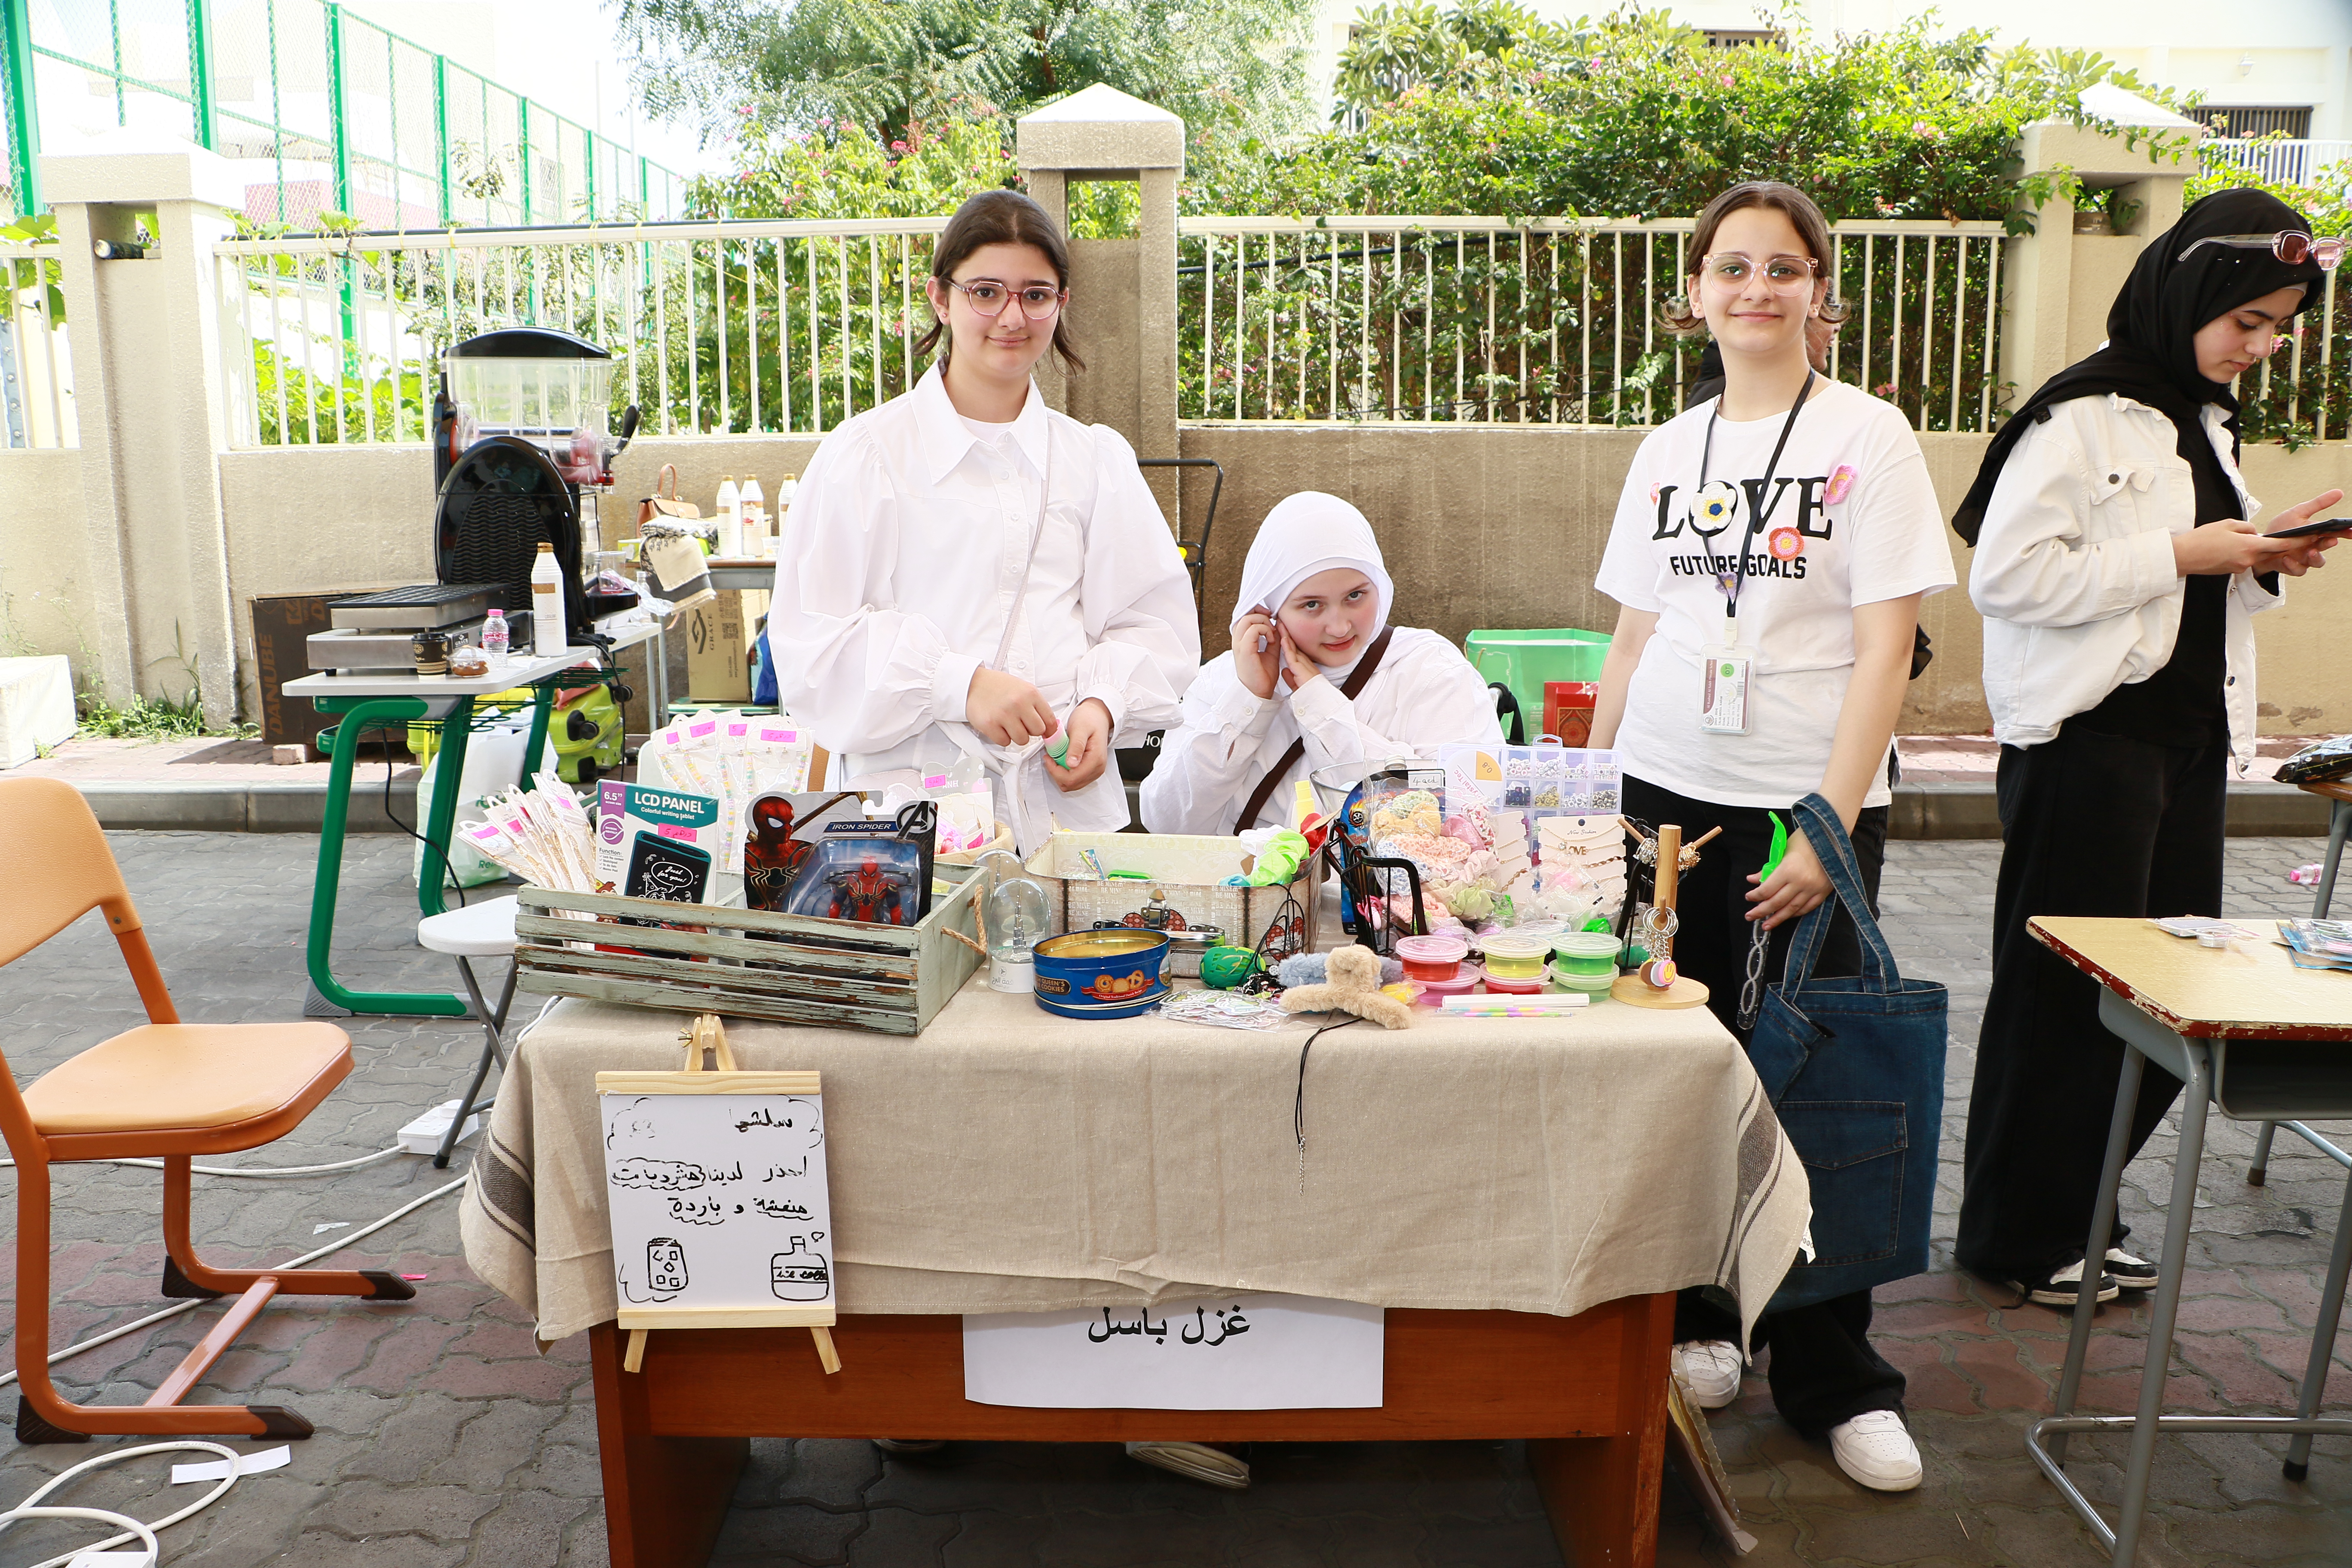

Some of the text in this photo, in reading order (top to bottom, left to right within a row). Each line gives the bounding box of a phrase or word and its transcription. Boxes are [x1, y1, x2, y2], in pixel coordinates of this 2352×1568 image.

[1670, 554, 1807, 579] FUTURE GOALS
[455, 637, 469, 646] GRACE
[1725, 666, 1730, 675] OT
[259, 633, 284, 735] DANUBE
[1482, 762, 1493, 773] 0.8
[1454, 769, 1464, 782] Tec
[1412, 776, 1421, 786] 4
[634, 792, 705, 814] LCD PANEL
[662, 810, 679, 819] writing
[599, 847, 622, 856] Function:
[665, 866, 683, 875] Just
[669, 875, 687, 883] you!
[1041, 978, 1065, 987] QUEEN'S
[1041, 984, 1065, 992] COOKIES
[668, 1196, 721, 1216] باردة
[733, 1204, 744, 1214] و
[1088, 1304, 1251, 1346] غزل باسل
